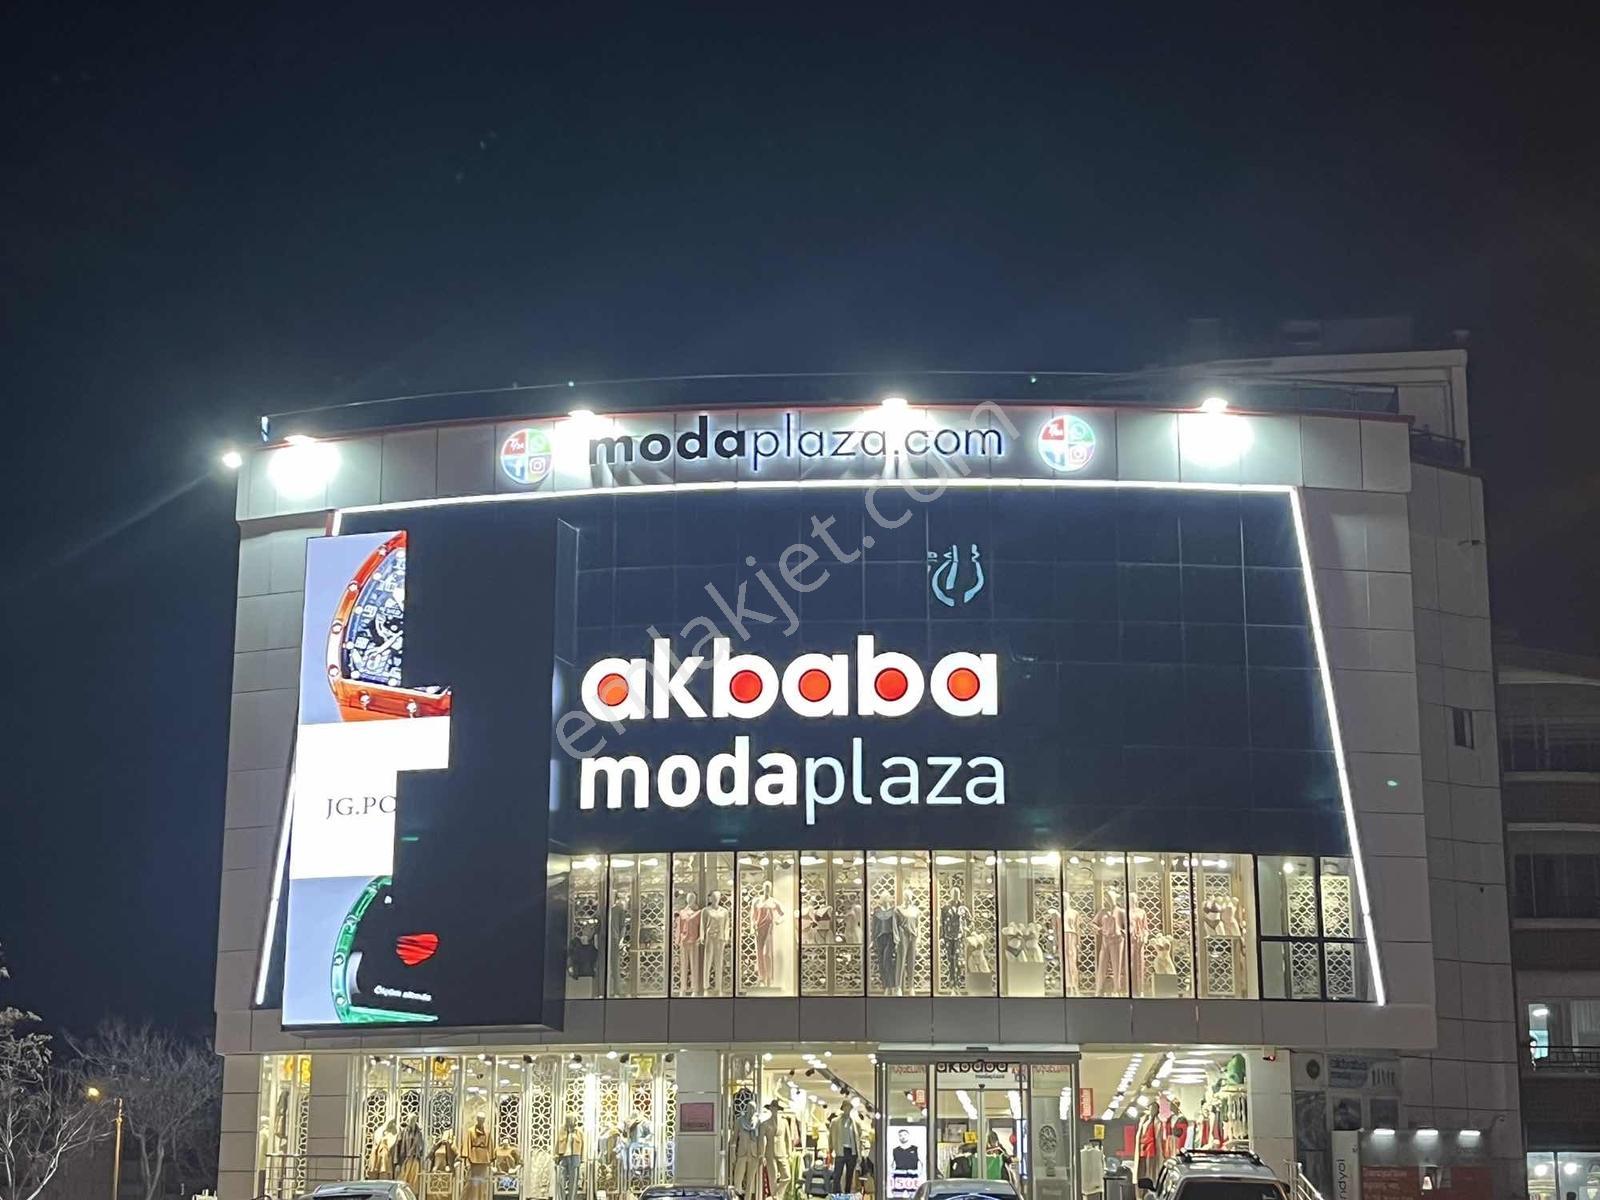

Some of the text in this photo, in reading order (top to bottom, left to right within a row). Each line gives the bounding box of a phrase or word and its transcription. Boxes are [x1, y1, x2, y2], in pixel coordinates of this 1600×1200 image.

[589, 413, 1004, 471] modaplaza.com
[581, 635, 998, 720] akbaba
[579, 735, 1006, 825] modaplaza
